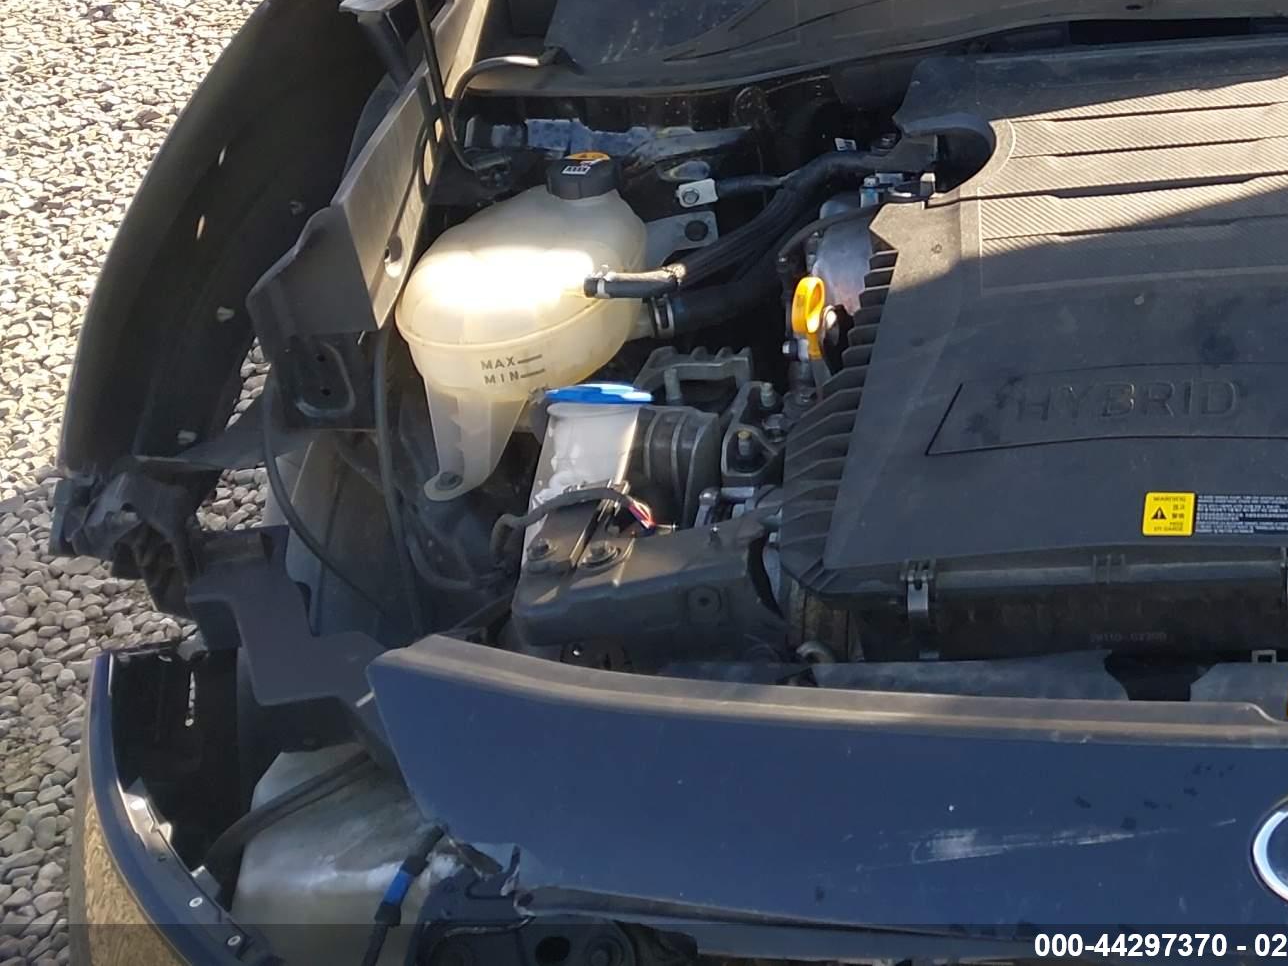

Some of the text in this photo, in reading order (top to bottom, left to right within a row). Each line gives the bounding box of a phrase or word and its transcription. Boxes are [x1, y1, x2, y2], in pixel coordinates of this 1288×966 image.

[480, 356, 516, 371] MAX
[483, 370, 520, 385] MIN
[1013, 378, 1239, 422] HYBRID
